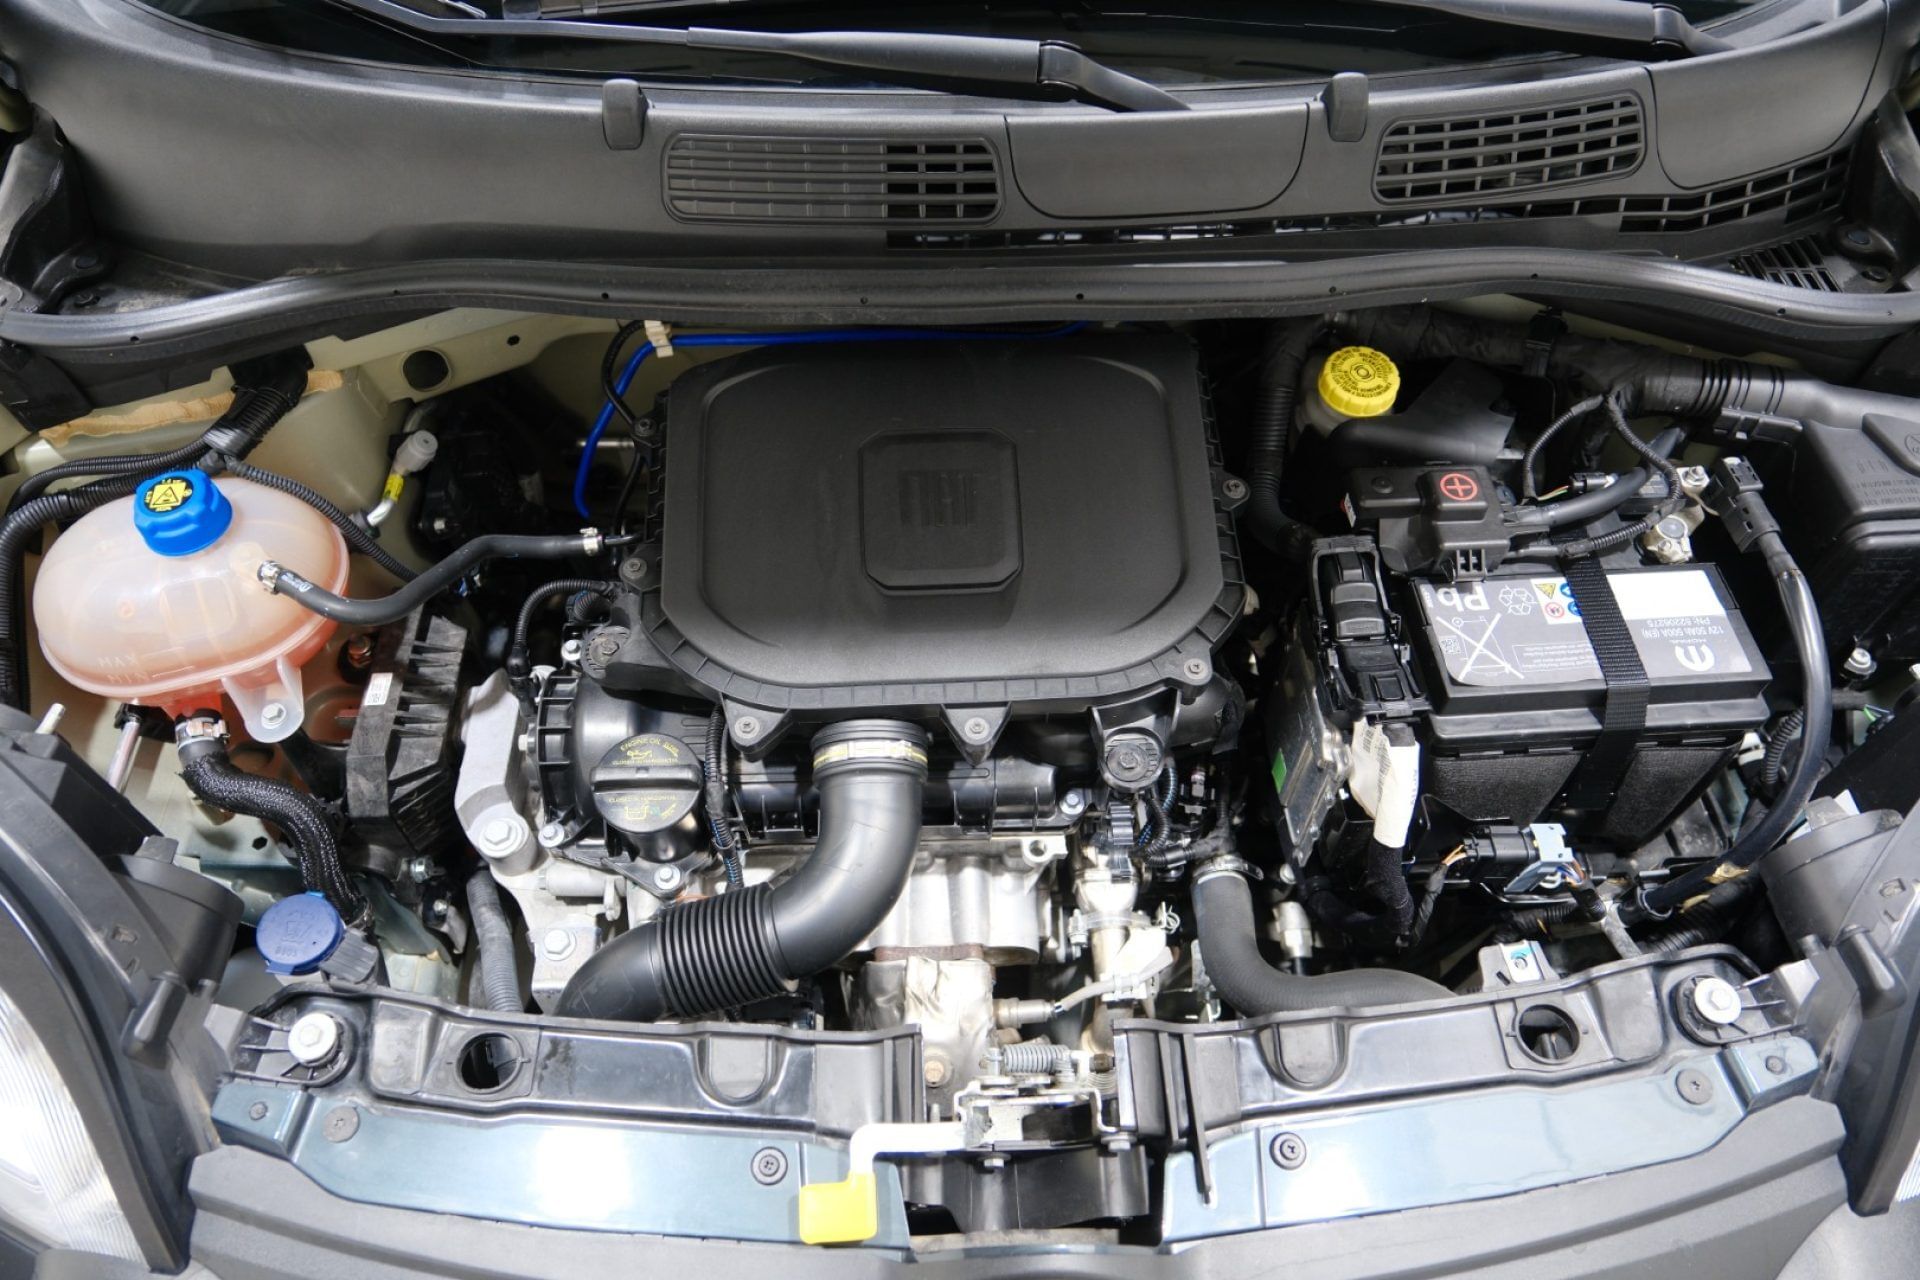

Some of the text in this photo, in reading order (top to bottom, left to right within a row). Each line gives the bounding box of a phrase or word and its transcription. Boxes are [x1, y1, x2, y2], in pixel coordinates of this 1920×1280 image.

[1436, 585, 1490, 612] Pb
[1708, 625, 1724, 635] 12V
[98, 652, 137, 668] MAX
